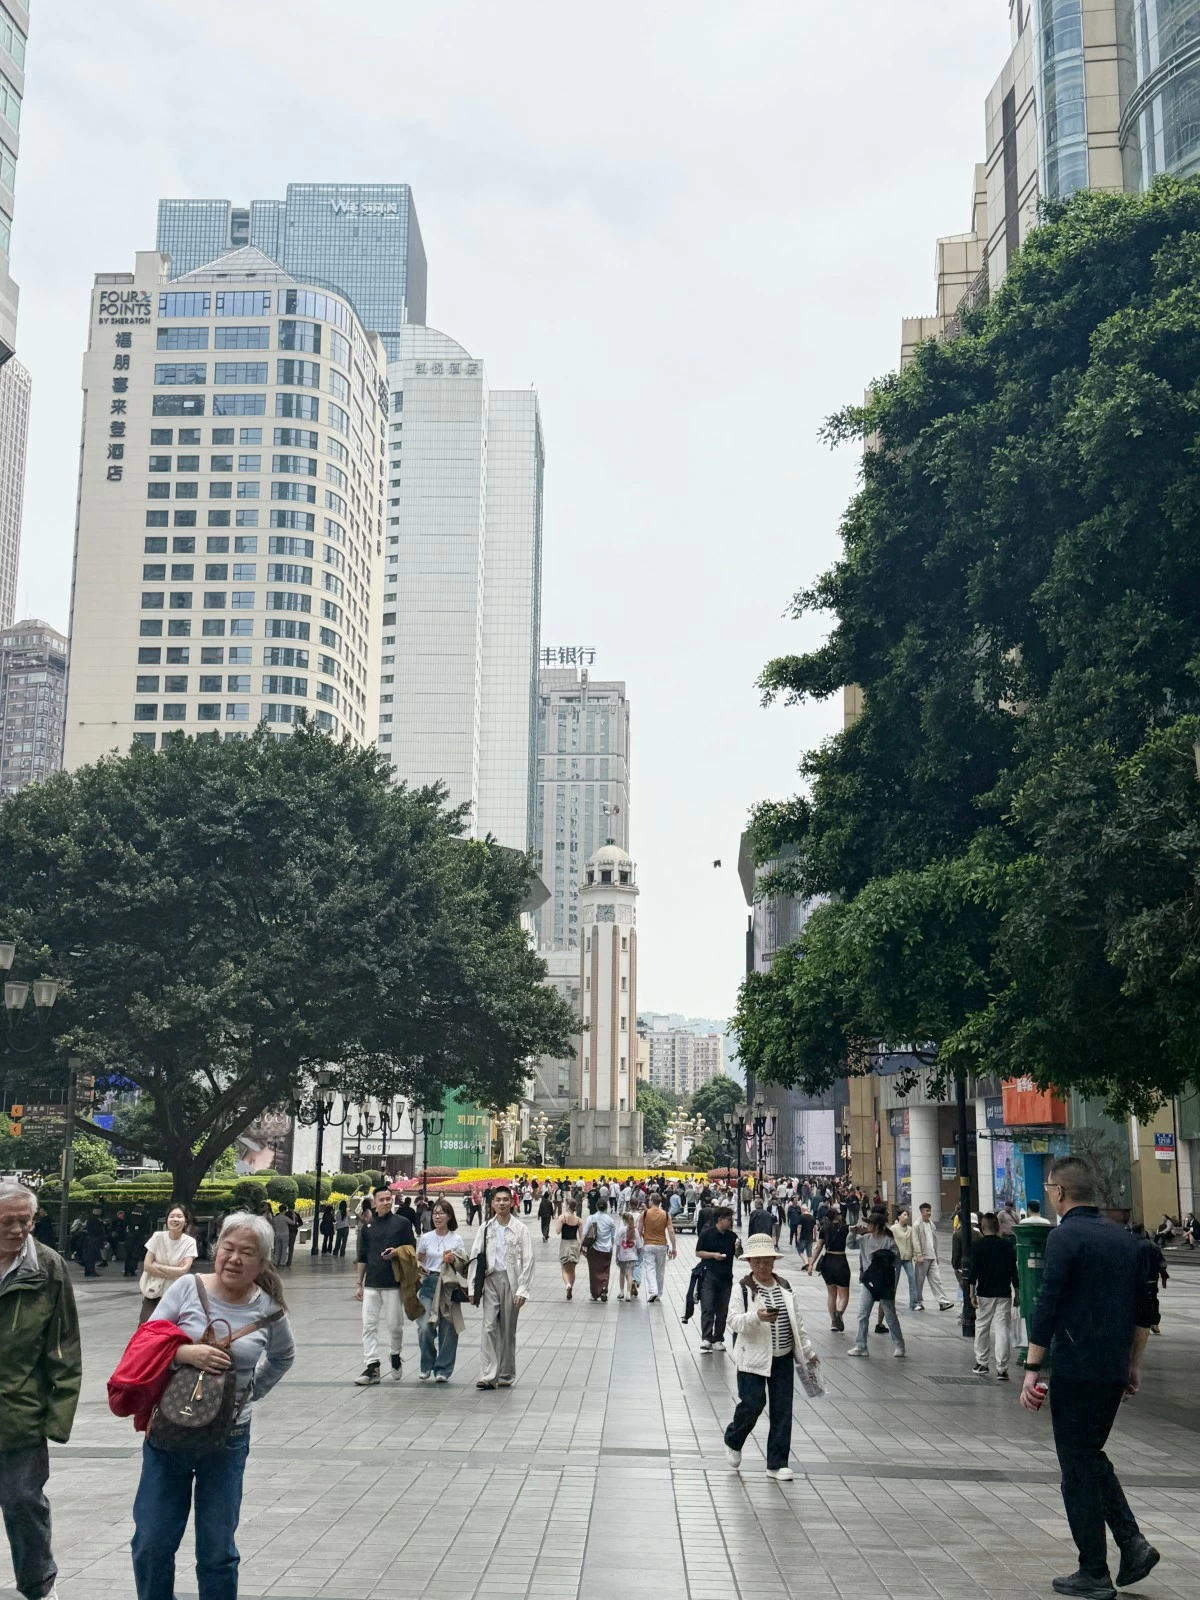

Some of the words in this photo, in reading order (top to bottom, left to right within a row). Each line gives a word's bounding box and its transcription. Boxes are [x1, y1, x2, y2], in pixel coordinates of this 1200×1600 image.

[99, 290, 140, 303] FOUR
[99, 303, 152, 316] POINTS
[98, 317, 109, 325] BY
[110, 316, 151, 325] SHERATON
[415, 362, 478, 375] 凯悦酒店
[106, 331, 132, 481] 福朋喜来登酒店
[540, 646, 597, 666] 丰银行
